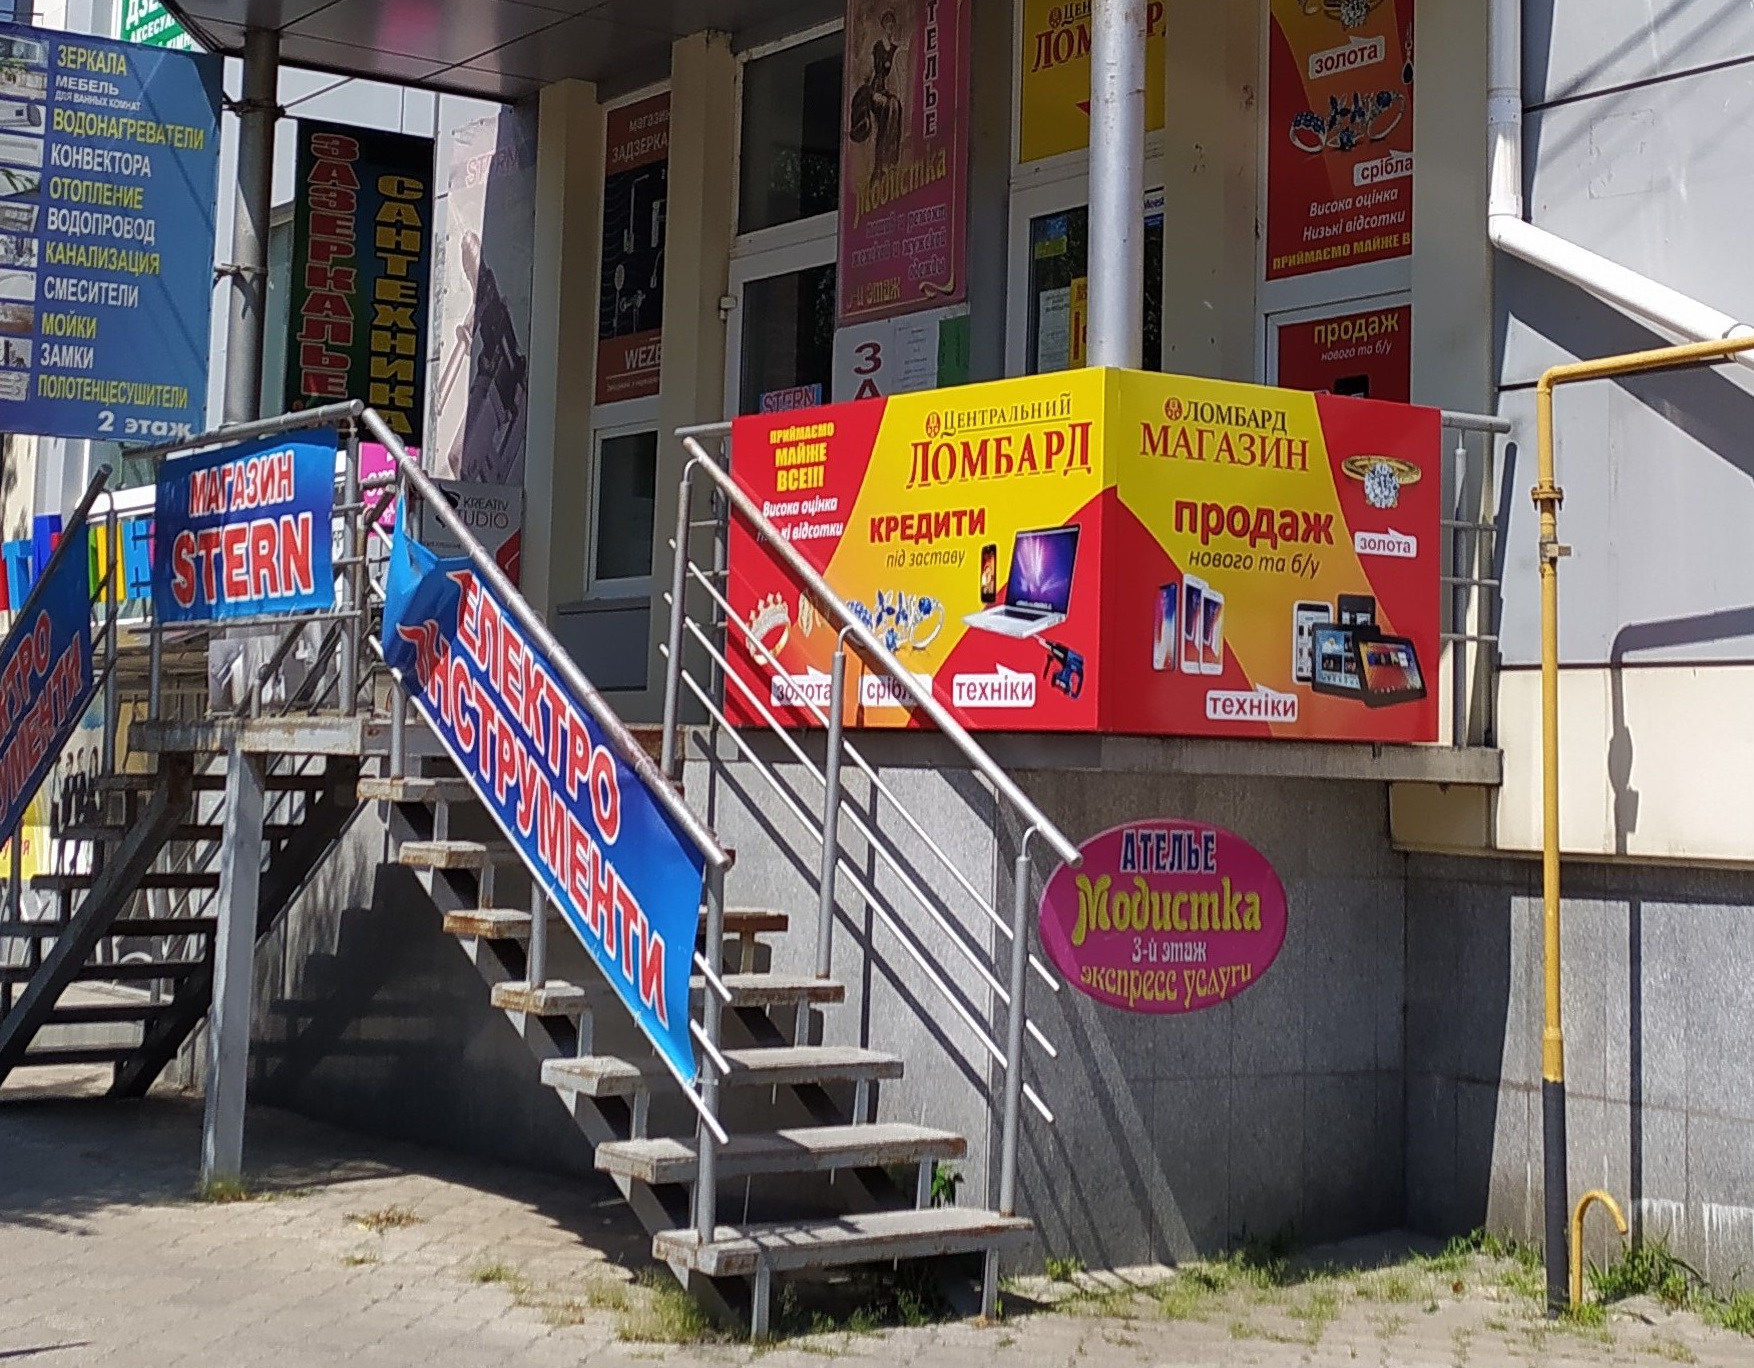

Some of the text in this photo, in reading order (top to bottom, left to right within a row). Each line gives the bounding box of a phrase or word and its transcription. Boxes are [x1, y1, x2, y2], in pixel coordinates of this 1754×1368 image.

[57, 44, 128, 76] ЗЕРКАЛА
[1315, 44, 1378, 74] золота
[54, 90, 73, 102] ДЛЯ
[109, 97, 141, 111] КОМНАТ
[55, 74, 120, 96] МЕБЕЛЬ
[53, 108, 205, 150] ВОДОНАГРЕВАТЕЛИ
[51, 142, 152, 178] КОНВЕКТОРА
[1361, 157, 1413, 182] срібла
[50, 176, 144, 209] ОТОПЛЕНИЕ
[1310, 188, 1399, 218] Висока оцінка
[47, 206, 155, 247] ВОДОПРОВОД
[1303, 210, 1406, 242] Низькі відсотки
[45, 241, 160, 277] КАНАЛИЗАЦИЯ
[1272, 243, 1350, 270] ПРИЙМАЄМО
[1353, 234, 1399, 254] МАЙЖЕ
[44, 276, 139, 308] СМЕСИТЕЛИ
[367, 174, 424, 435] САНТЕХНИКА
[41, 309, 97, 339] МОЙКИ
[1314, 313, 1399, 349] продаж
[40, 342, 94, 369] ЗАМКИ
[1321, 348, 1356, 361] нового
[38, 374, 188, 409] ПОЛОТЕНЦЕСУШИТЕЛИ
[98, 410, 192, 439] 2 этаж
[941, 392, 1071, 439] ЦЕНТРАЛЬНИЙ
[1184, 400, 1287, 434] ЛОМБАРД
[775, 442, 827, 468] МАЙЖЕ
[906, 422, 1093, 489] ЛОМБАРД
[1140, 422, 1309, 472] МАГАЗИН
[189, 450, 295, 517] МАГАЗИН
[463, 496, 510, 511] KREATIV
[763, 495, 838, 517] Висока оцінка
[791, 522, 843, 541] відсотки
[870, 508, 986, 545] КРЕДИТИ
[1174, 499, 1334, 551] продаж
[171, 512, 315, 608] STERN
[886, 549, 966, 568] під заставу
[1359, 535, 1411, 555] золота
[1188, 551, 1320, 579] нового та б/у
[956, 674, 1034, 701] техніки
[446, 568, 620, 845] ЕЛЕКТРО
[1209, 692, 1297, 719] техніки
[1120, 829, 1217, 874] АТЕЛЬЕ
[1071, 874, 1262, 947] Модистка
[1162, 941, 1207, 962] этаж
[1081, 963, 1252, 1009] экспресс услуги
